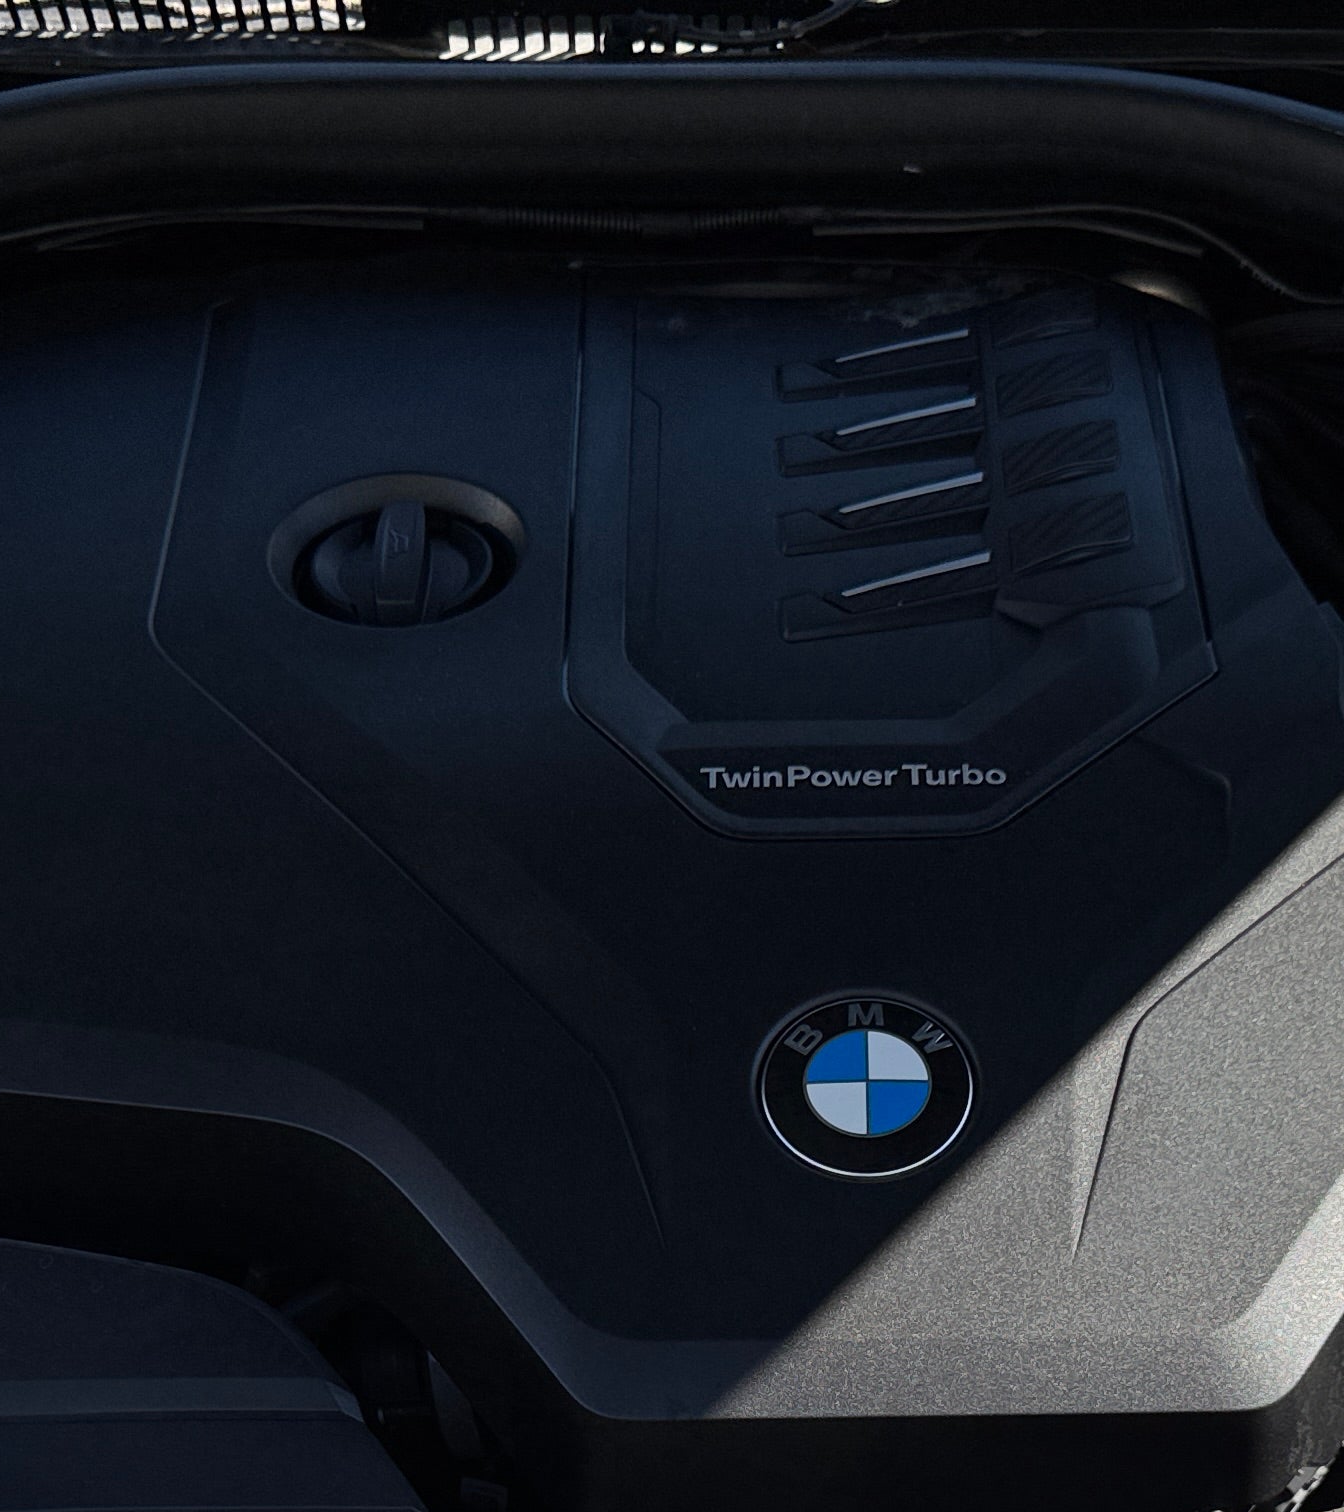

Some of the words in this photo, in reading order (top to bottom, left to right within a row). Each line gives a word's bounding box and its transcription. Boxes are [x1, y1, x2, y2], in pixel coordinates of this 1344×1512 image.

[699, 764, 898, 790] TwinPower
[901, 762, 1007, 787] Turbo
[782, 1002, 954, 1056] BMW
